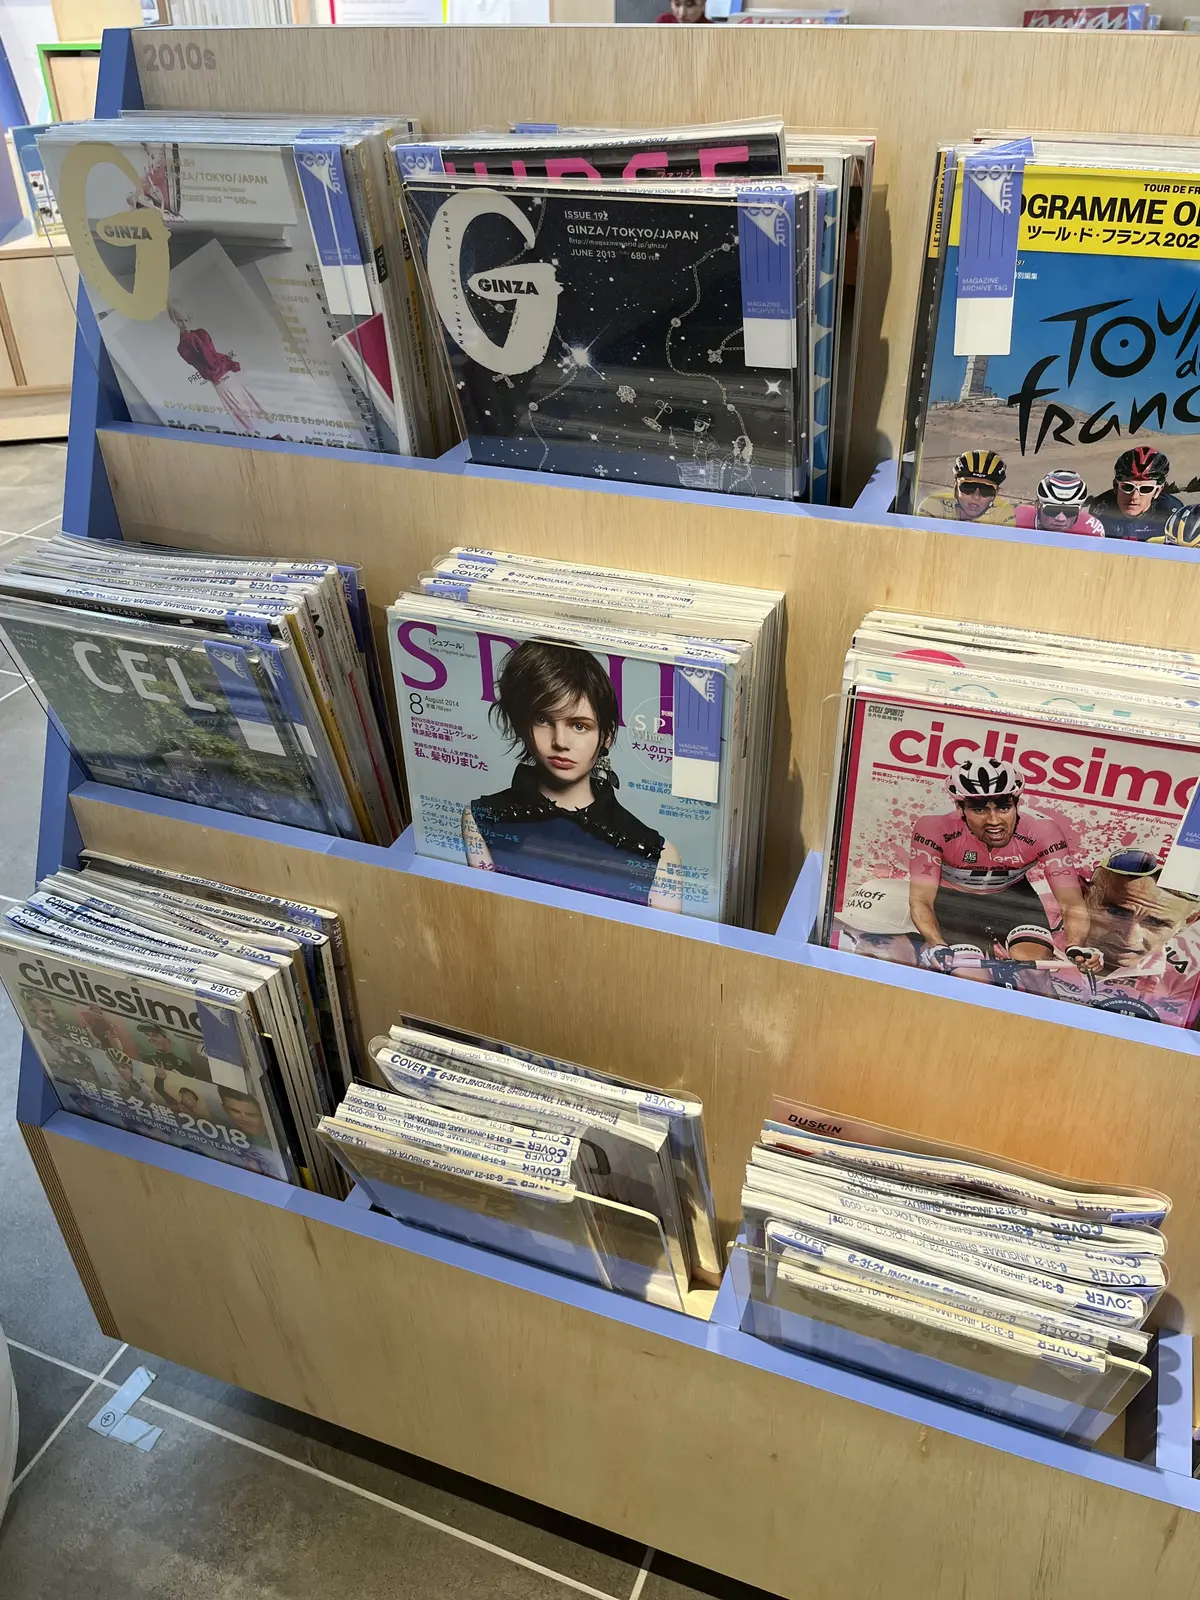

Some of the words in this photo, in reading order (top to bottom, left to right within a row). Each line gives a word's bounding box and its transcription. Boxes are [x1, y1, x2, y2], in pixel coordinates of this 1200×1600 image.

[143, 44, 216, 72] 2010s
[1143, 183, 1171, 194] TOUR
[1172, 185, 1187, 195] DE
[563, 210, 592, 220] ISSUE
[103, 224, 153, 241] GINZA
[566, 224, 700, 241] GINZA/TOKYO/JAPAN
[570, 249, 594, 257] JUNE
[596, 250, 617, 259] 2013
[630, 252, 648, 261] 680
[477, 278, 539, 296] GINZA
[961, 284, 993, 292] ARCHIVE
[994, 284, 1008, 292] TAG
[962, 277, 999, 285] MAGAZINE
[457, 562, 495, 574] COVER
[72, 640, 217, 713] CEL
[409, 692, 424, 715] 8
[424, 695, 445, 706] August
[444, 699, 460, 708] 2014
[884, 707, 905, 719] SPORTS
[414, 747, 489, 772] 私、髪切りました
[287, 925, 322, 941] COVER
[332, 922, 343, 948] PERK
[210, 983, 245, 998] COVER
[65, 1023, 88, 1036] 2018
[70, 1032, 92, 1049] 56
[391, 1053, 427, 1076] COVER
[439, 1069, 466, 1086] 6-31-21
[464, 1078, 506, 1094] JINGUMAE,
[644, 1094, 686, 1114] COVER
[143, 1115, 172, 1133] GUIDE
[172, 1127, 186, 1138] TO
[188, 1133, 211, 1145] PRO
[786, 1113, 843, 1135] DUSKIN
[486, 1132, 513, 1145] 6-31-21
[527, 1141, 568, 1158] COVER
[431, 1160, 475, 1177] JINGUMAE,
[479, 1153, 507, 1167] 6-31-21
[474, 1170, 504, 1183] 6-31-21
[522, 1163, 561, 1177] COVER
[979, 1242, 1031, 1264] JINGUMAE,
[847, 1253, 884, 1273] 6-31-21
[973, 1258, 1029, 1284] JINGUMAE,
[1034, 1257, 1068, 1274] 6-31-21
[1028, 1276, 1065, 1294] 6-31-21
[1088, 1267, 1147, 1286] COVER
[979, 1322, 1015, 1340] 6-31-21
[1036, 1338, 1096, 1363] COVER
